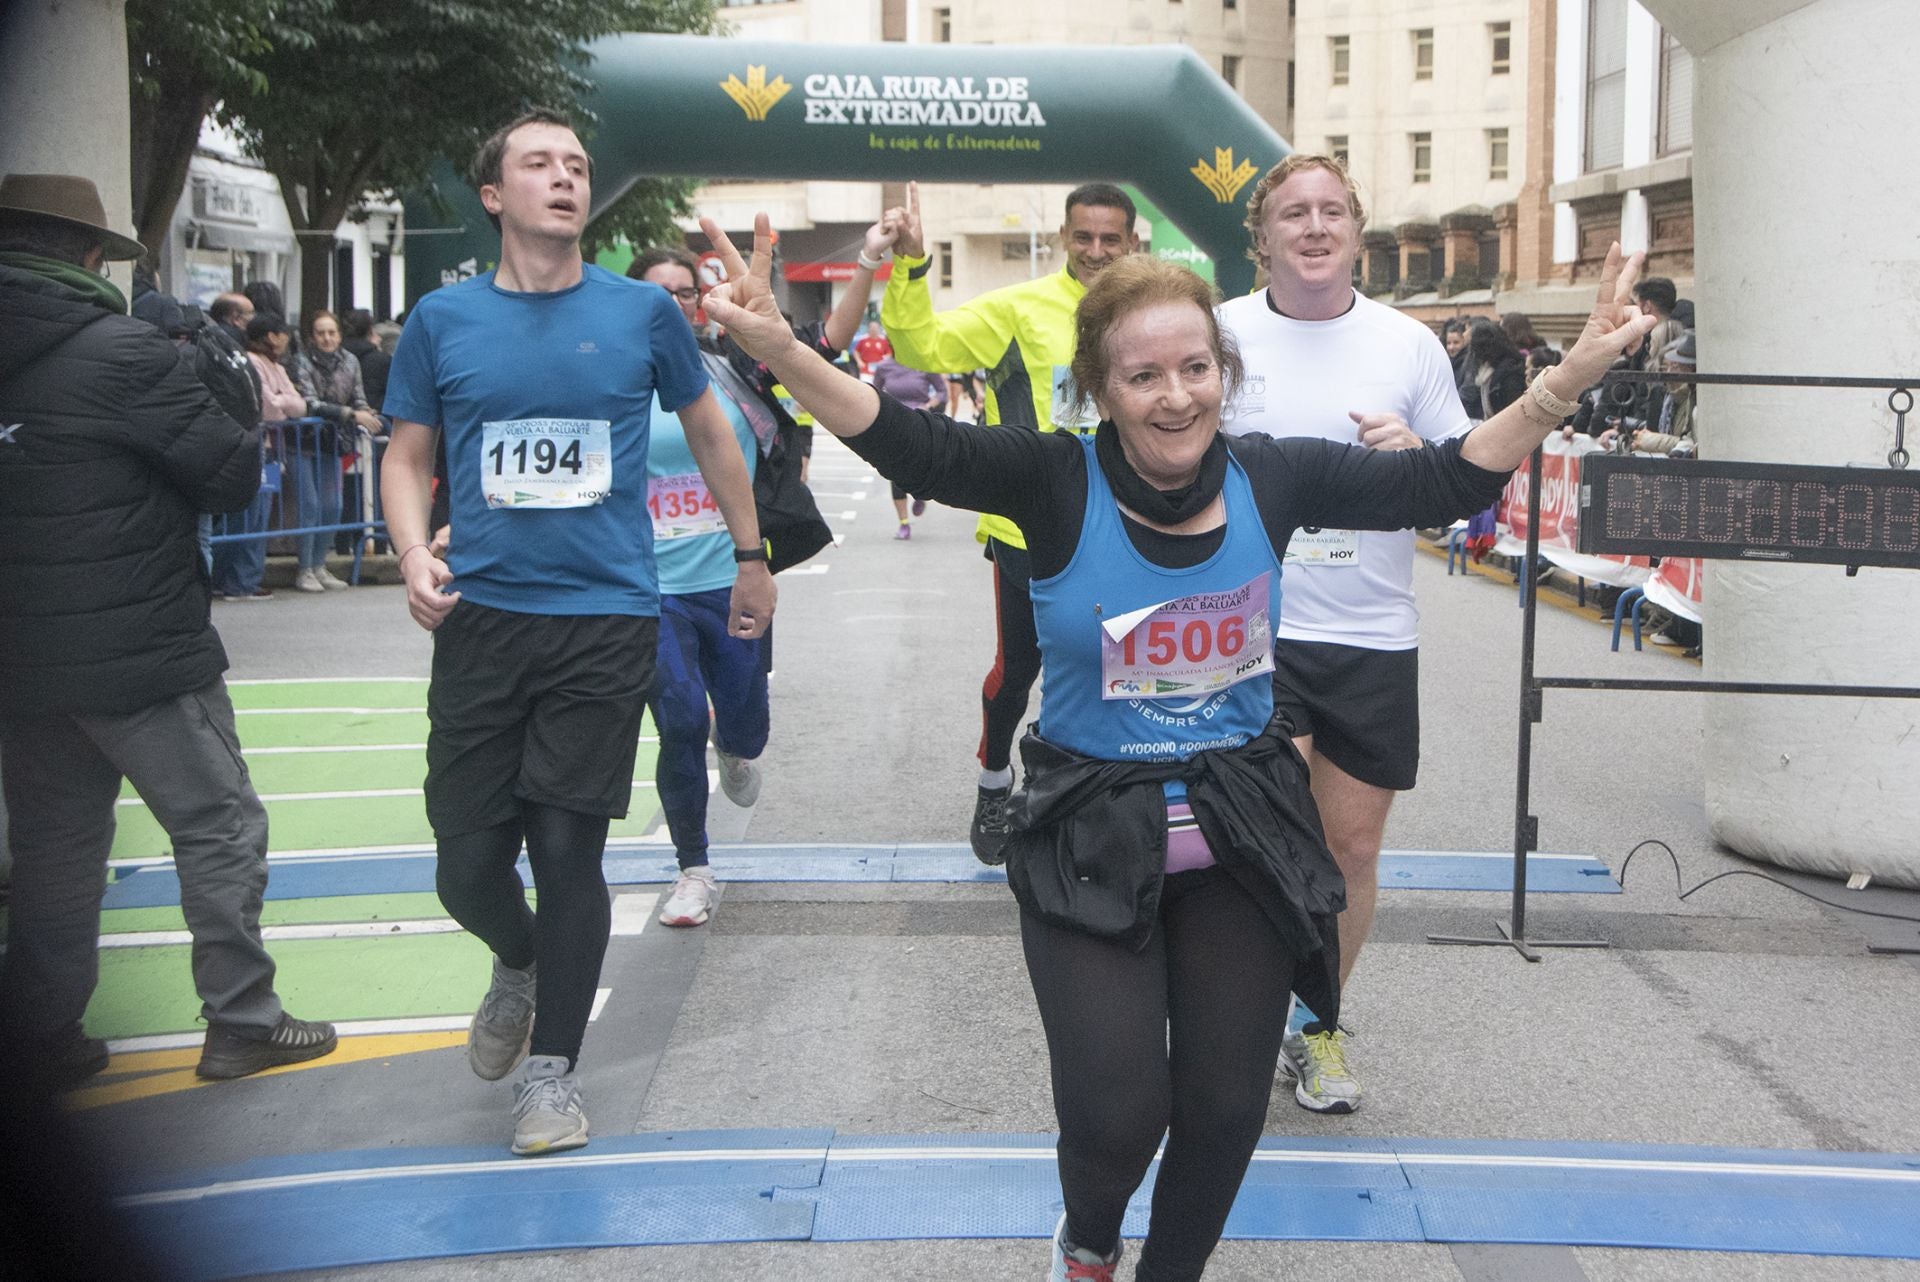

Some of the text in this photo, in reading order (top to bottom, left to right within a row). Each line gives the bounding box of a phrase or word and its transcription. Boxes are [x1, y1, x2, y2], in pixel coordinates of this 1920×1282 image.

[804, 75, 1029, 101] CAJA RURAL DE
[804, 100, 1047, 127] EXTREMADURA
[924, 135, 941, 150] de
[946, 133, 1042, 152] Extremadura
[505, 426, 532, 436] VUELTA
[548, 425, 591, 436] BALUARTE
[520, 420, 549, 428] CROSS
[550, 420, 591, 429] POPULAR
[488, 438, 583, 476] 1194
[648, 488, 719, 520] 1354
[1329, 550, 1354, 559] HOY
[1181, 602, 1196, 611] AL
[1200, 592, 1251, 611] BALUARTE
[1203, 585, 1251, 602] POPULAR
[1123, 615, 1245, 666] 1506
[1235, 654, 1265, 675] HOY
[1128, 696, 1199, 727] SIEMPRE
[1119, 741, 1176, 754] #YODONO
